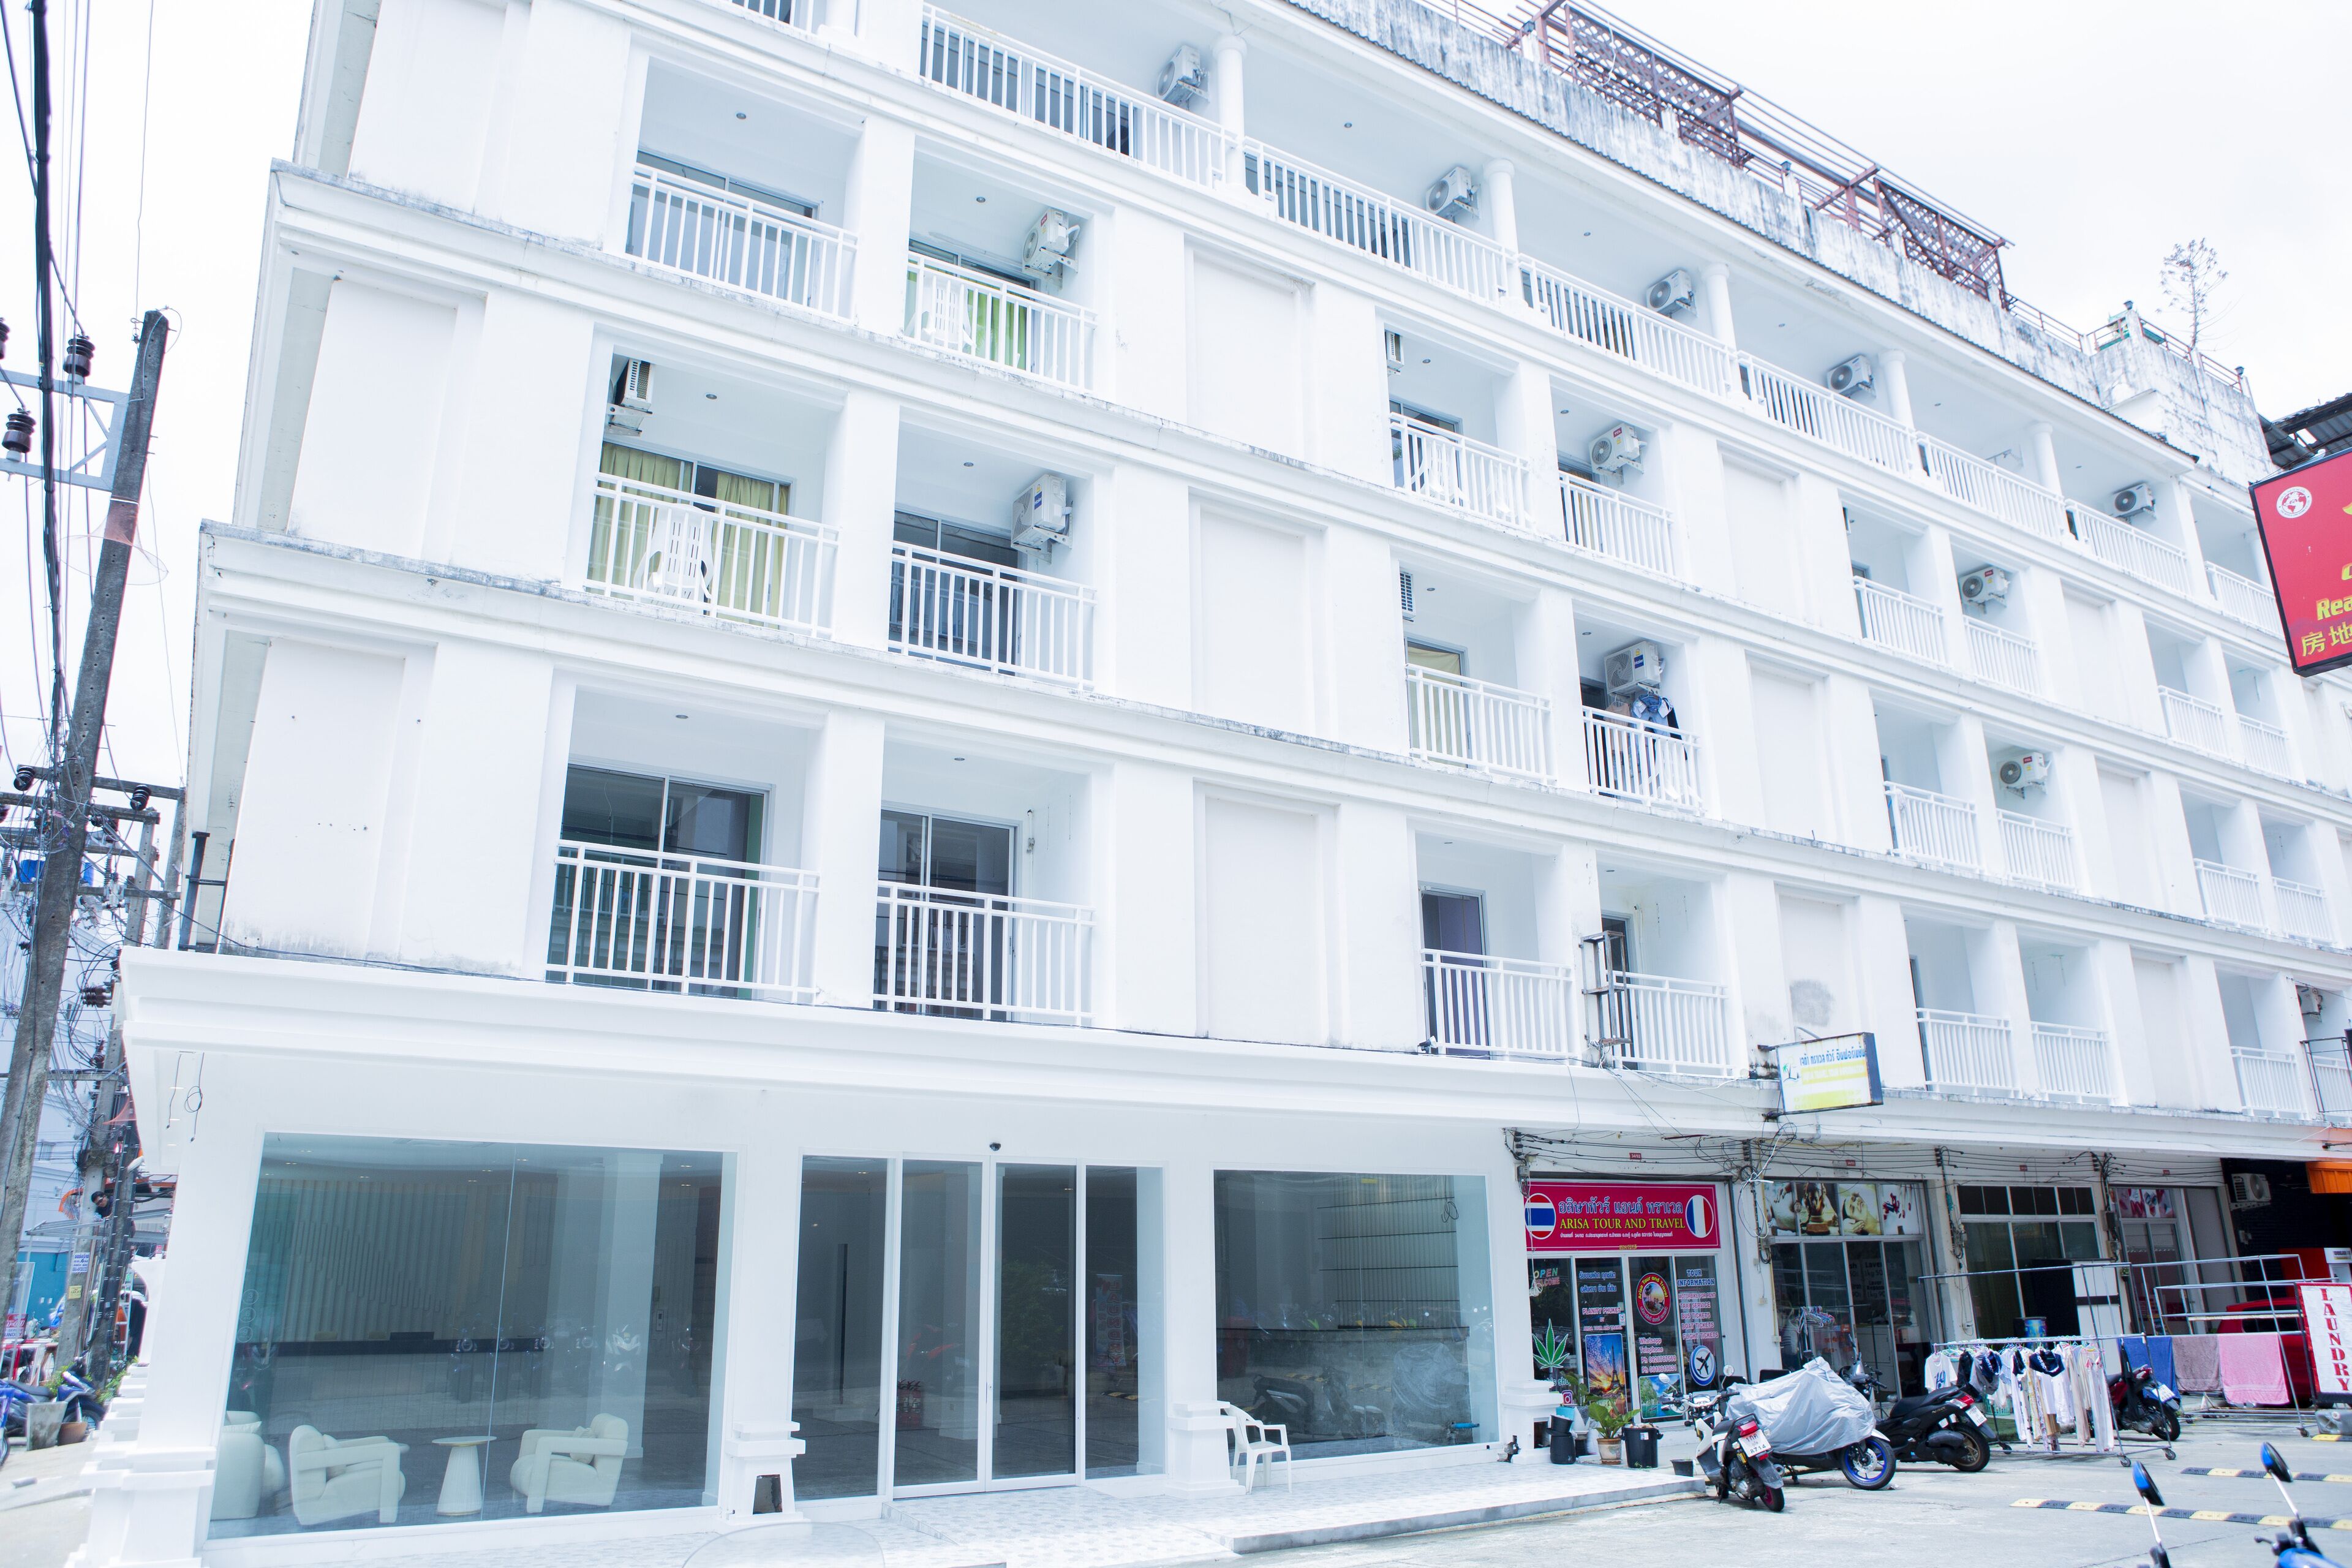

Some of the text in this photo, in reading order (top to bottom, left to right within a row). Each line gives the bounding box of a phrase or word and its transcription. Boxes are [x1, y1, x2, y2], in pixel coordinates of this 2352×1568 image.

[1558, 1196, 1683, 1214] อลิษาทัวร์ แอนด์ ทราเวล
[1559, 1218, 1686, 1229] ARISA TOUR AND TRAVEL
[1534, 1268, 1558, 1279] OPEN
[1660, 1280, 1668, 1297] Travel
[2320, 1288, 2350, 1392] LAUNDRY
[1639, 1346, 1664, 1355] Telephone
[1750, 1444, 1766, 1453] 8714
